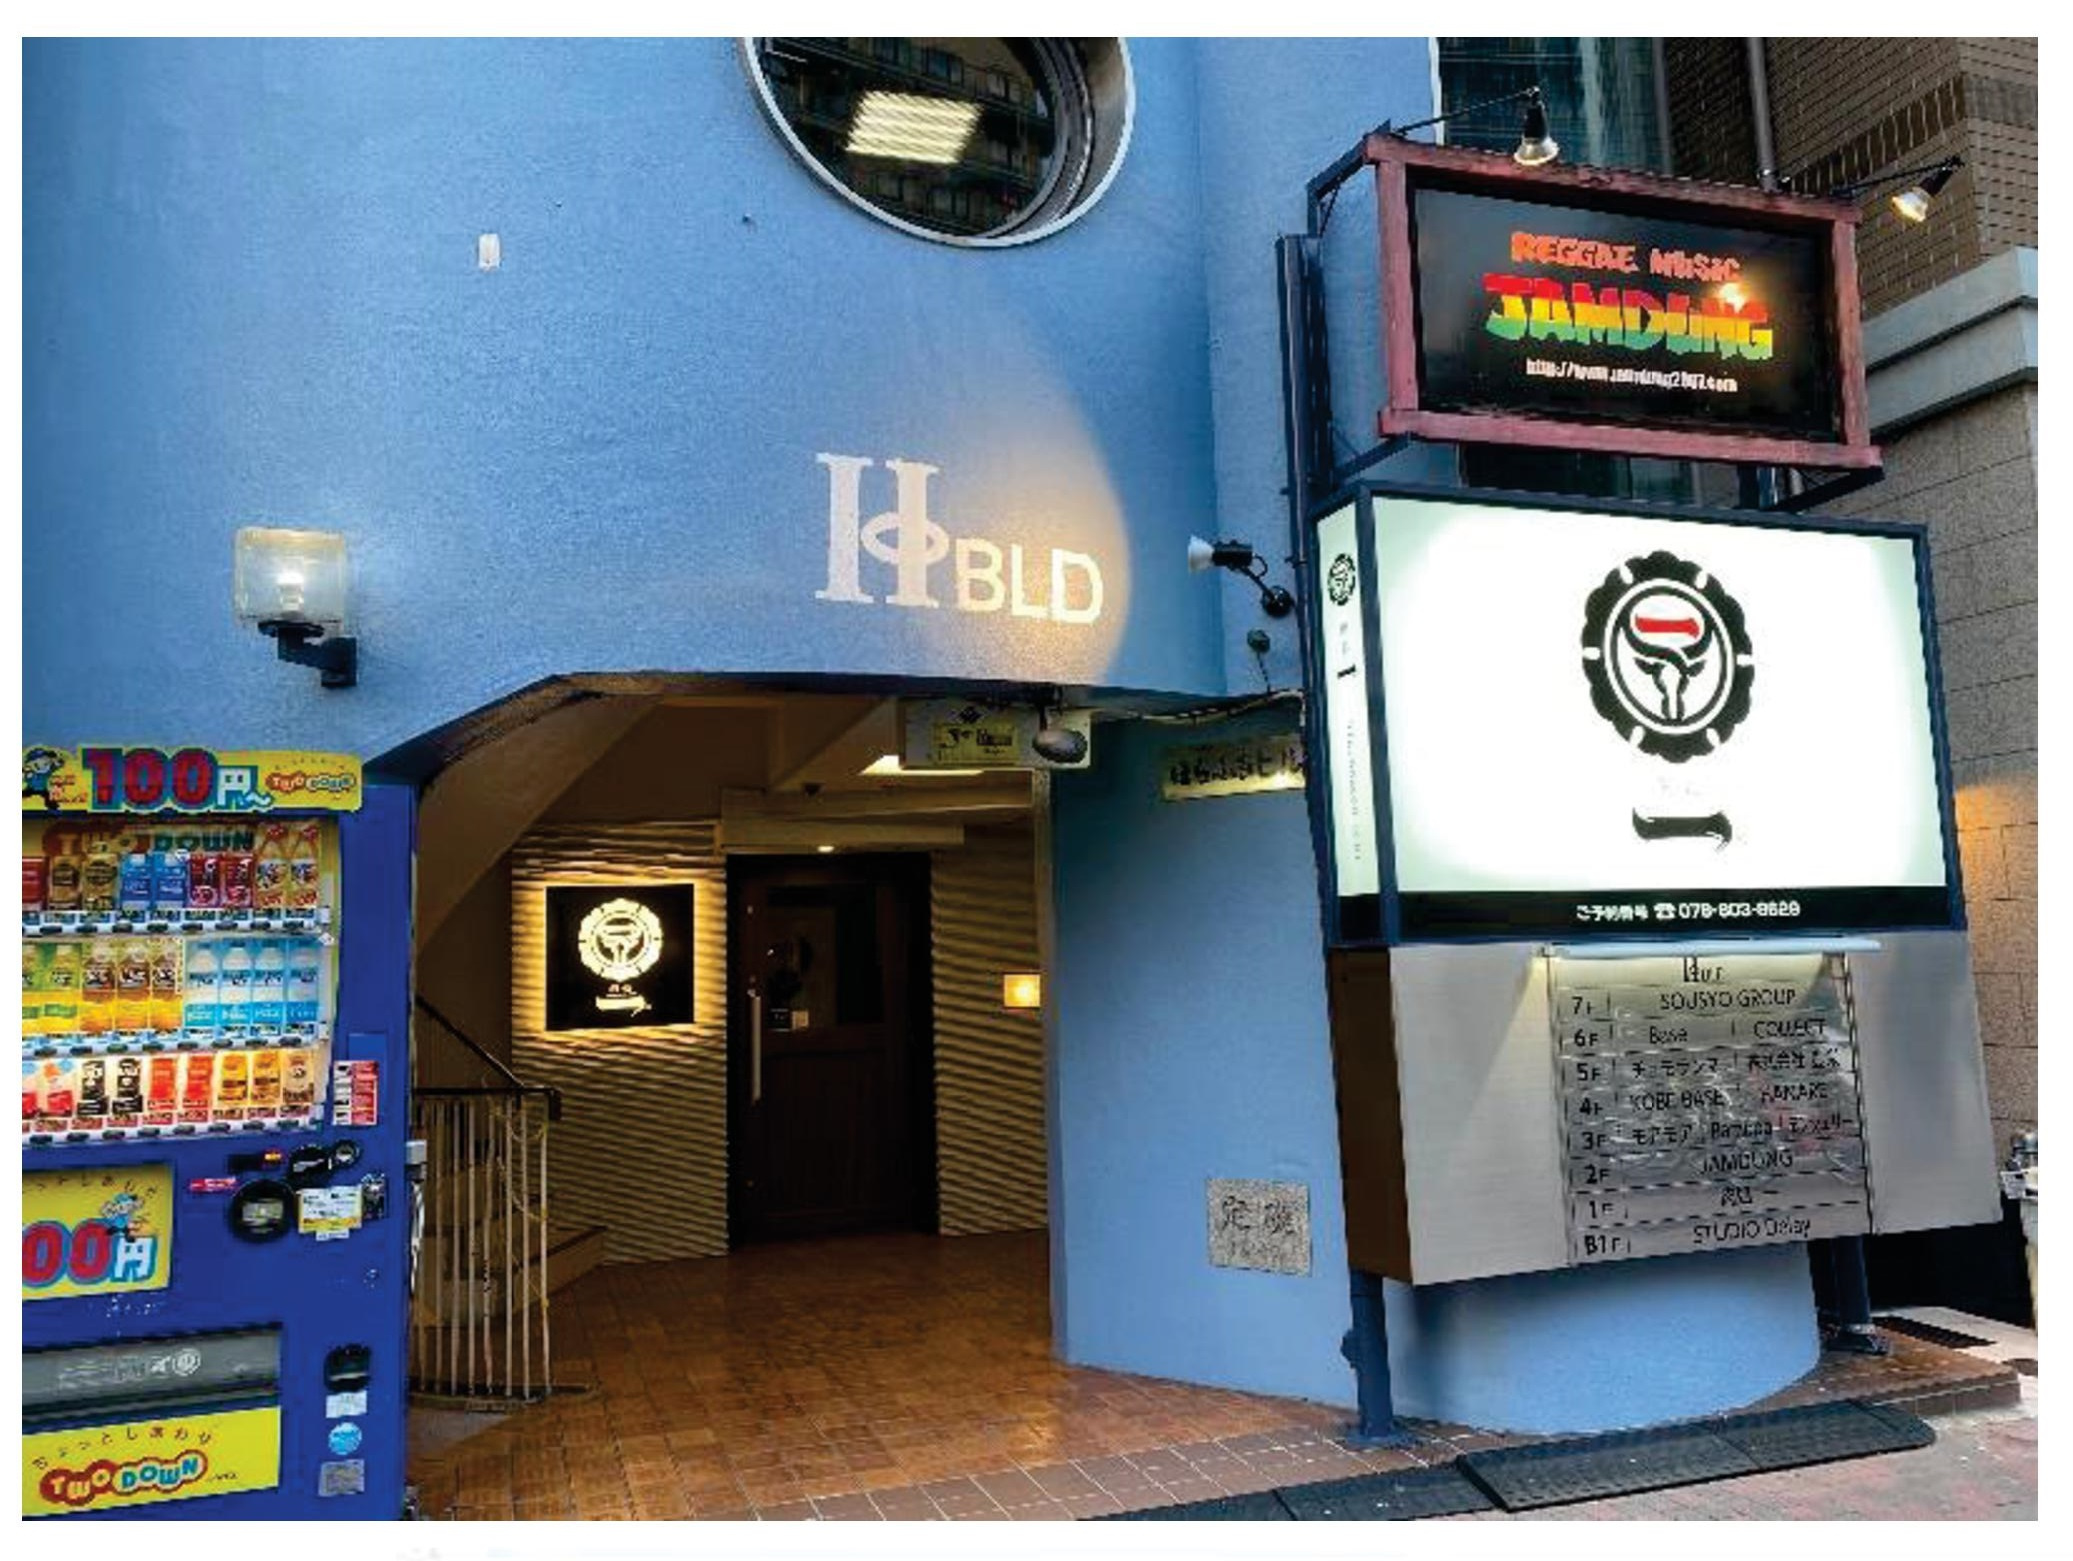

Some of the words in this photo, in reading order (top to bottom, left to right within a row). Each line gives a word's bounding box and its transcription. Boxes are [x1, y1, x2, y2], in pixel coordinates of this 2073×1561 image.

[1511, 231, 1640, 273] REGGAE
[1482, 272, 1774, 361] JAMDUNG
[955, 537, 1104, 623] BLD
[1737, 988, 1796, 1008] GROUP
[1574, 1028, 1599, 1047] 6F
[1577, 1062, 1601, 1081] 5F
[1582, 1131, 1607, 1149] 3F
[1586, 1164, 1611, 1184] 2F
[1588, 1200, 1614, 1219] 1F
[51, 1468, 112, 1502] TWO
[120, 1456, 200, 1490] DOWN
